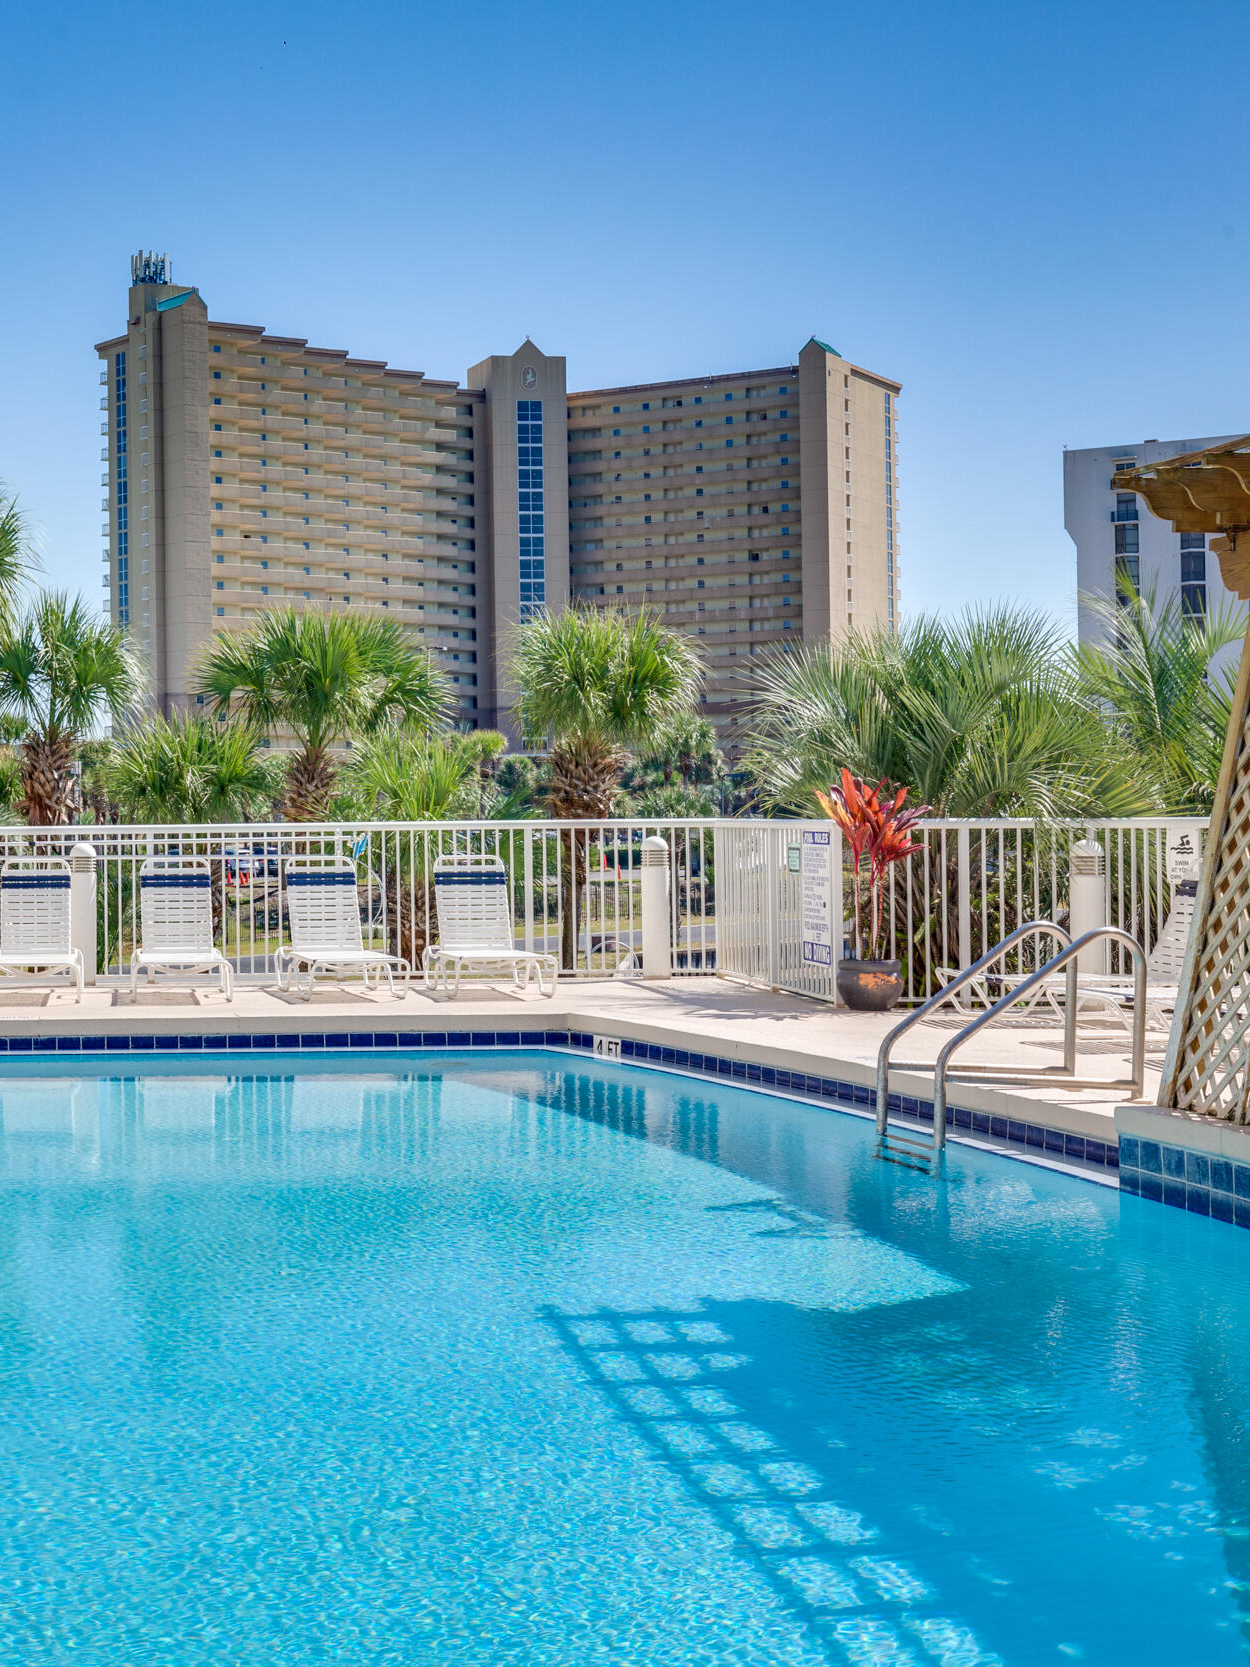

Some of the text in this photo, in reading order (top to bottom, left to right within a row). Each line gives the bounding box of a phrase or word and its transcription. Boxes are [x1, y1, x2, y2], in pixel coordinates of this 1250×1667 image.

[814, 832, 829, 844] RULES
[805, 943, 830, 964] NO DIVING
[608, 1041, 619, 1052] FT
